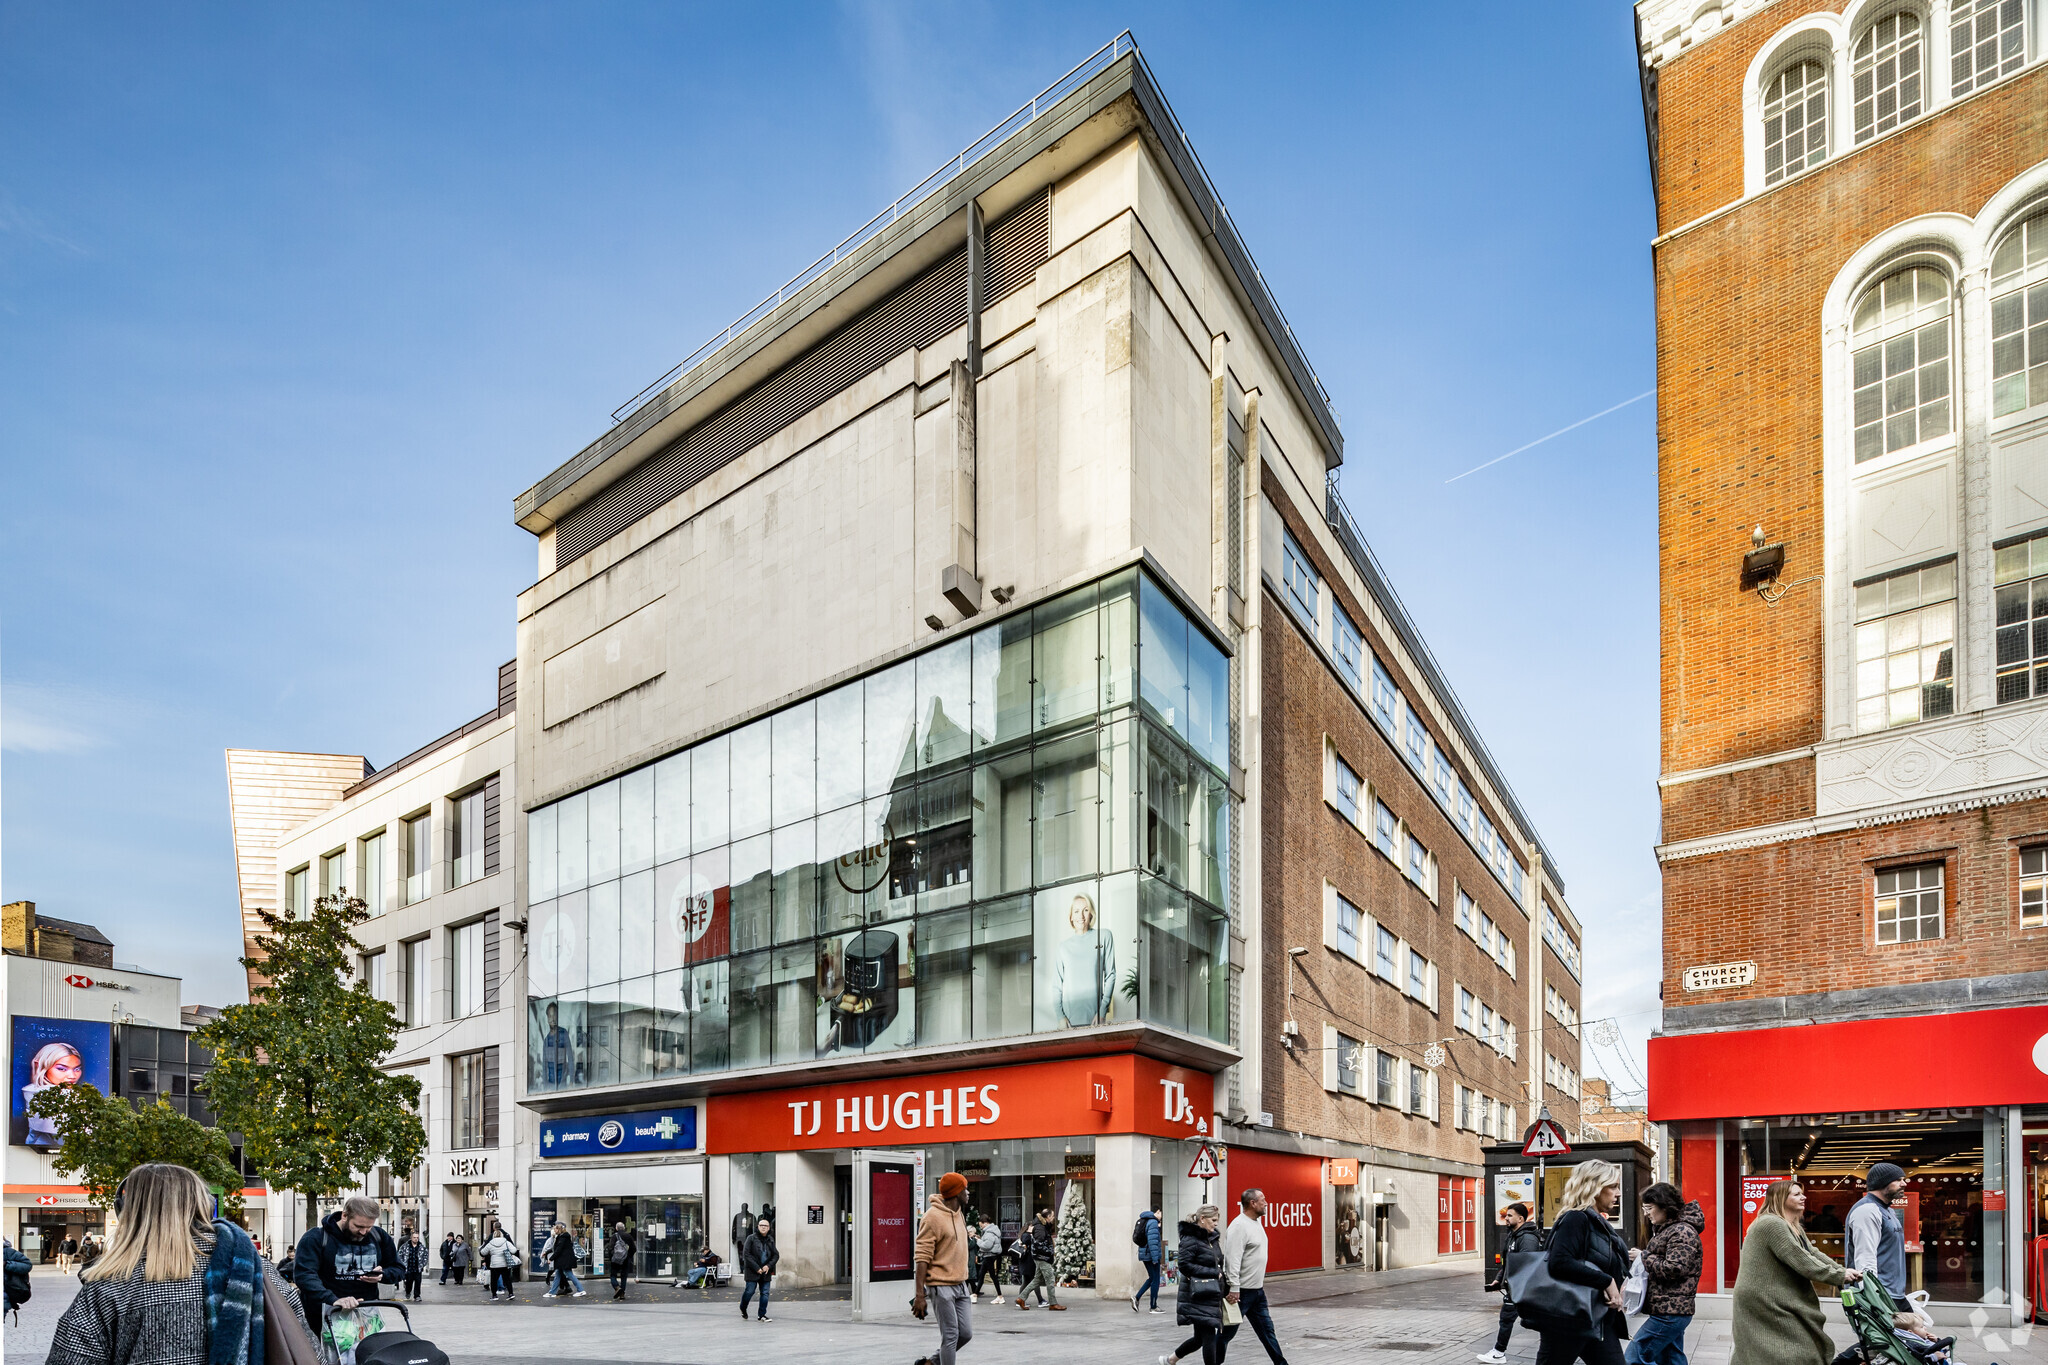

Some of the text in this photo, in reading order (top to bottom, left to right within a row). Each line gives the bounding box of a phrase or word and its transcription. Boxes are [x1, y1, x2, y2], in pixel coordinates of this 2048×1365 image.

[677, 909, 707, 934] OFF
[1692, 965, 1747, 978] CHURCH
[96, 981, 131, 992] HSBC UK
[1694, 975, 1746, 987] STREET
[1093, 1083, 1109, 1102] TJ's
[1160, 1079, 1194, 1125] TJ's
[788, 1084, 1001, 1136] TJ HUGHES
[562, 1132, 590, 1143] pharmacy
[635, 1126, 657, 1137] beauty
[450, 1158, 488, 1176] NEXT
[1066, 1165, 1095, 1173] CHRISTM
[1335, 1166, 1354, 1178] TJ's
[1743, 1182, 1769, 1190] Save
[1744, 1190, 1767, 1199] £684
[877, 1218, 905, 1226] TANGOBET
